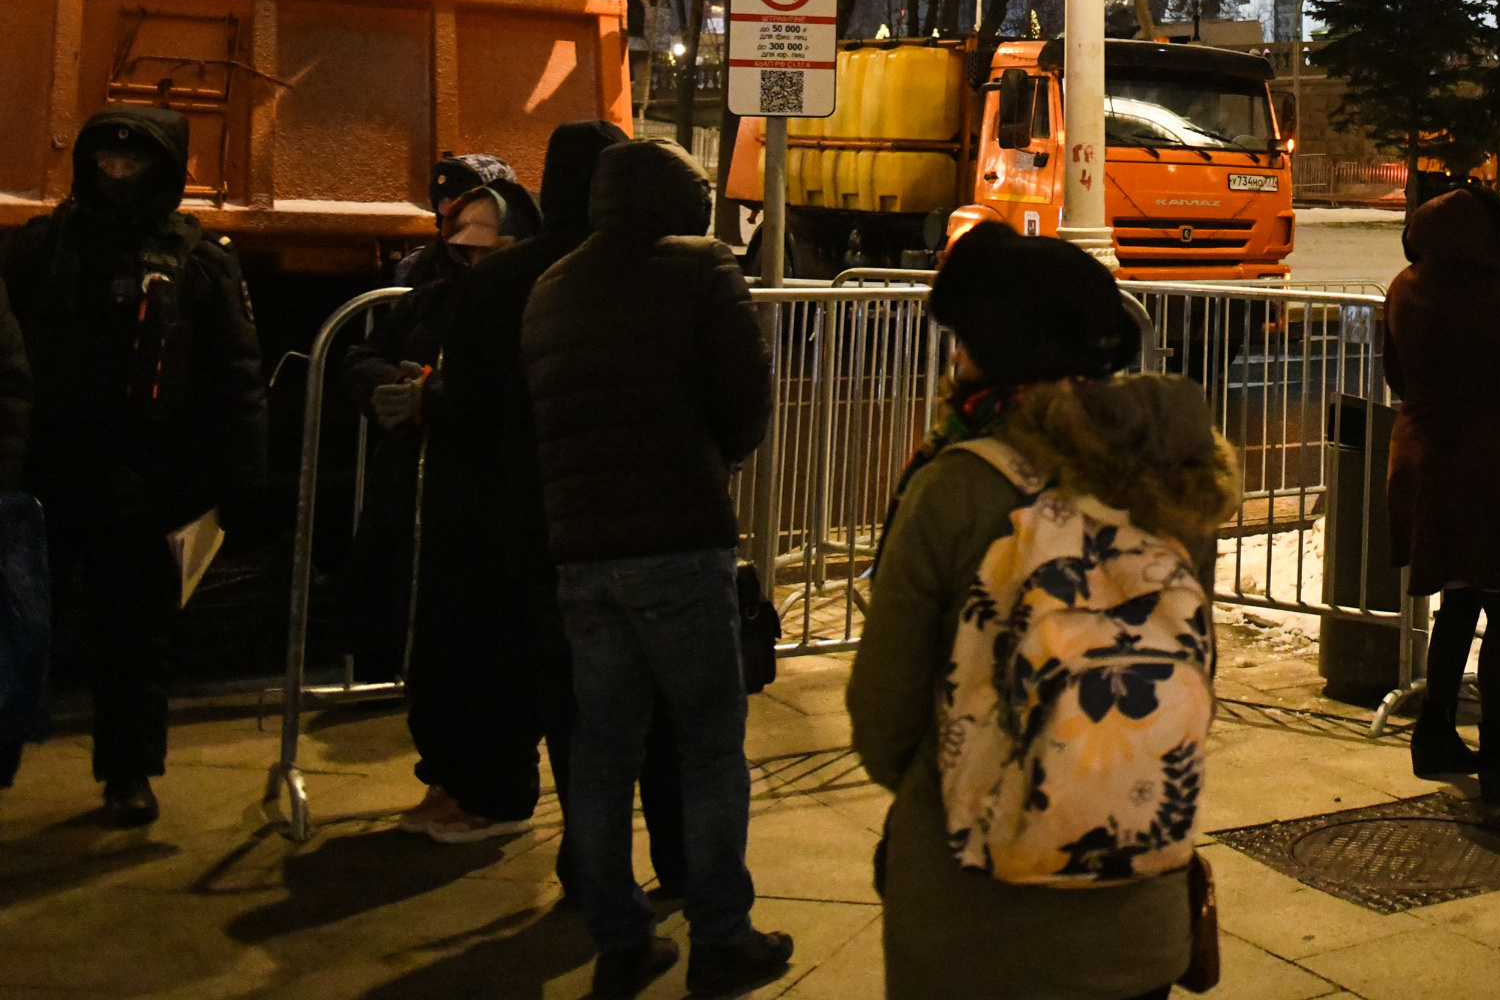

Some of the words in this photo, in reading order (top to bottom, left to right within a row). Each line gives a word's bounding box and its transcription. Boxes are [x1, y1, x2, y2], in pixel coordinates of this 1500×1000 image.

[772, 24, 783, 33] 50
[785, 25, 801, 34] 000
[769, 42, 785, 51] 300
[787, 43, 803, 51] 000
